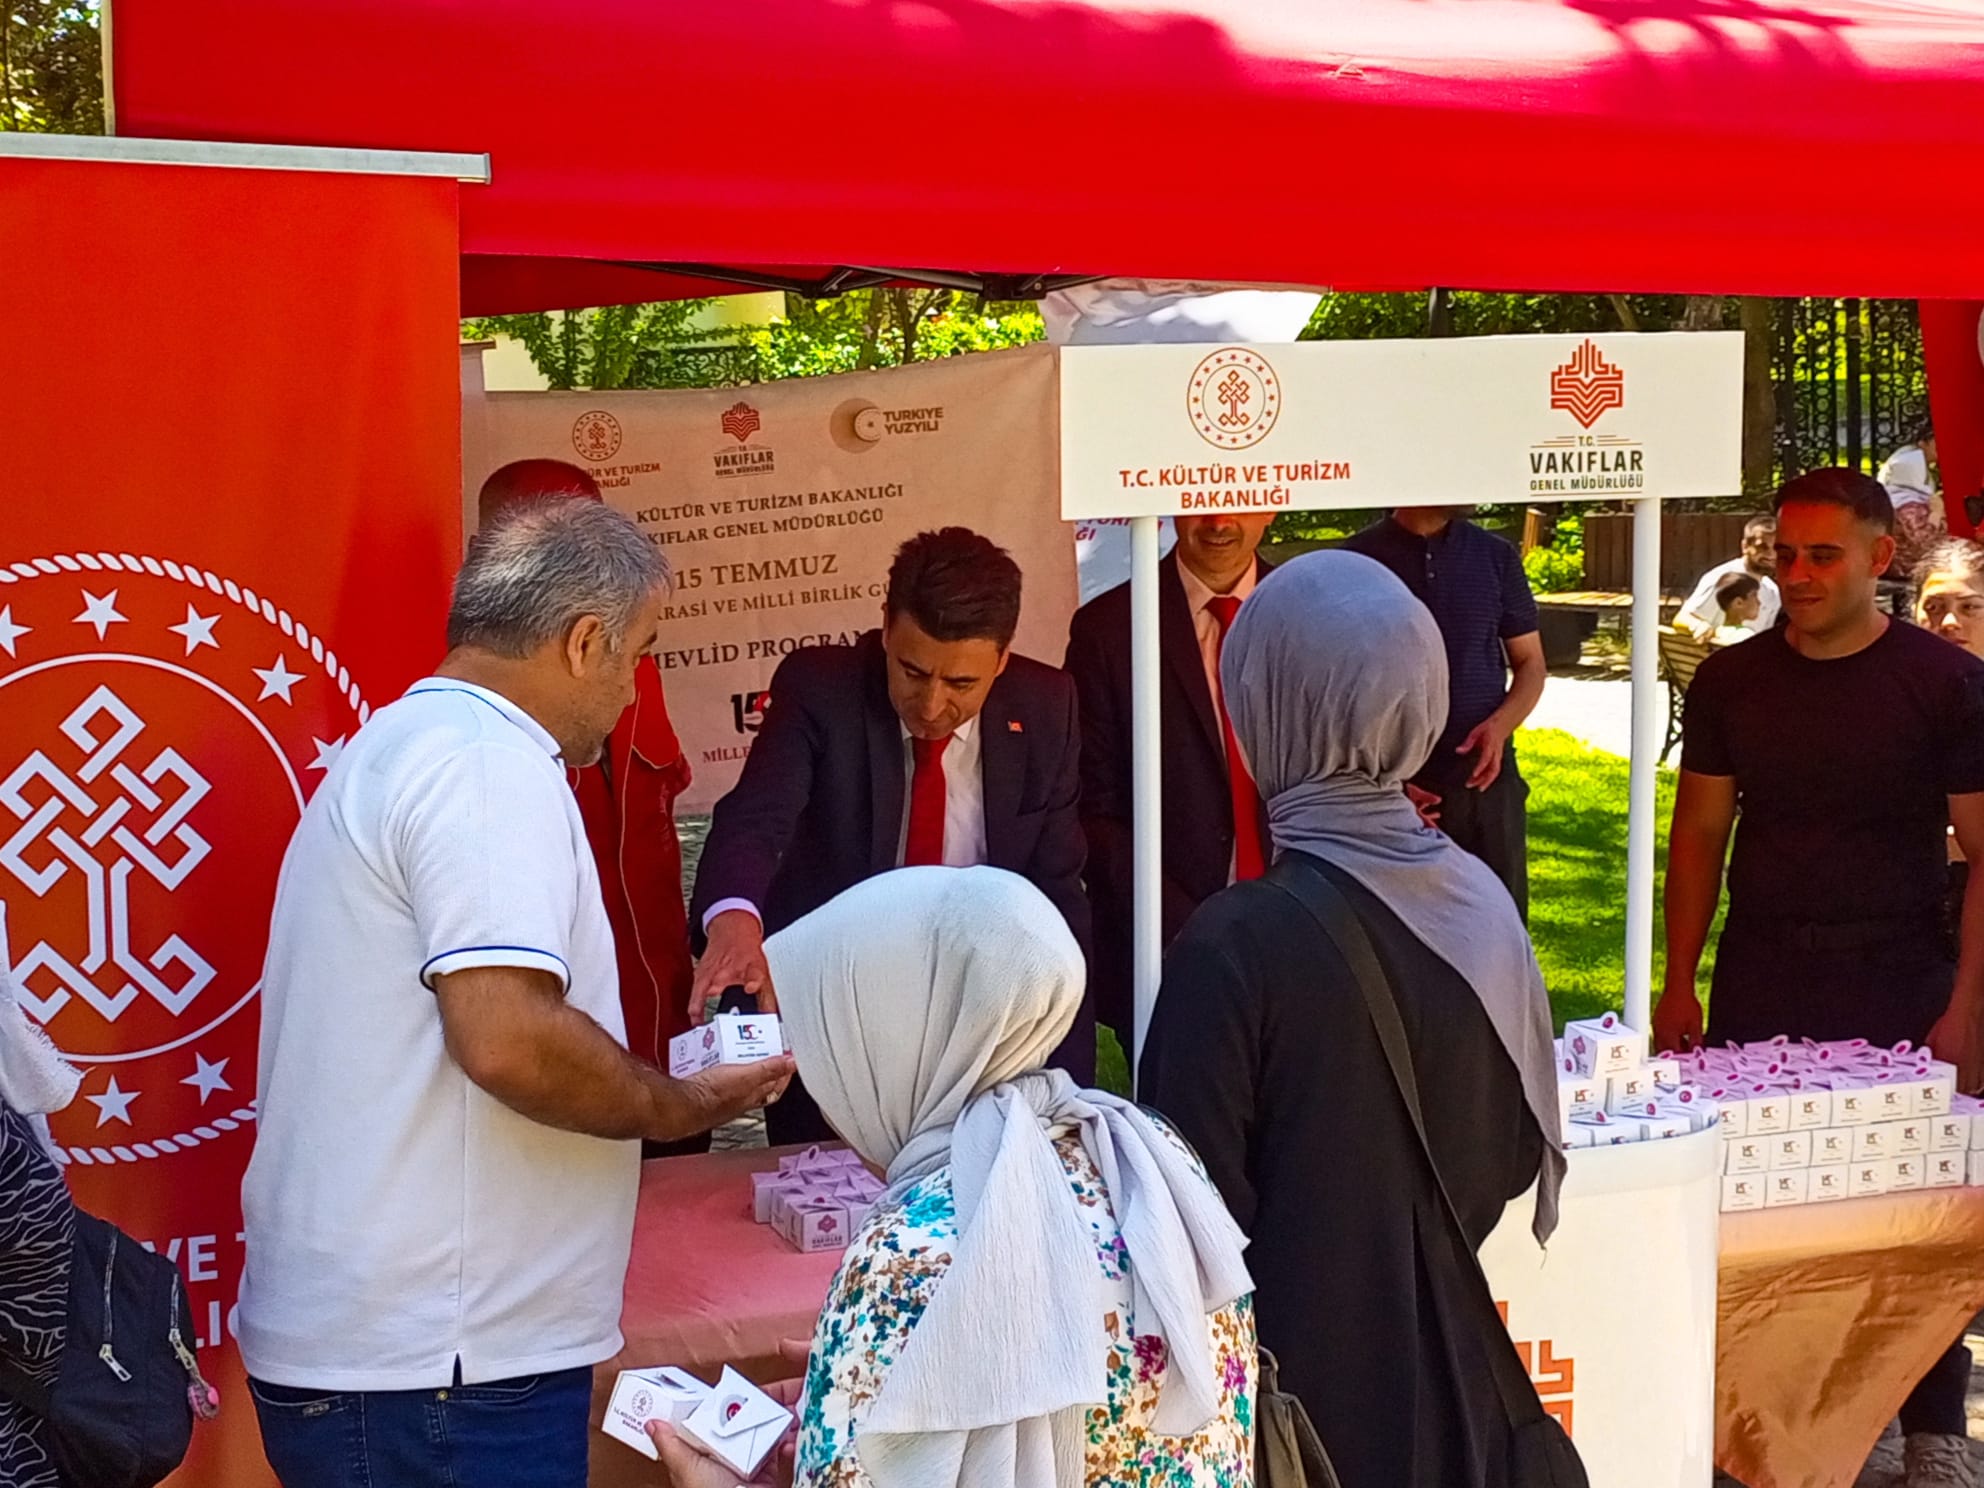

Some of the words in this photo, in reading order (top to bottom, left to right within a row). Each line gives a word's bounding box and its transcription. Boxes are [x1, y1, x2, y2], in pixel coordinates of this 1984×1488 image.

[1578, 436, 1595, 447] T.C.
[604, 466, 618, 477] VE
[620, 463, 660, 475] TURİZM
[714, 451, 774, 467] VAKIFLAR
[1530, 450, 1643, 474] VAKIFLAR
[1119, 470, 1153, 487] T.C.
[1159, 463, 1237, 485] KÜLTÜR
[1242, 466, 1268, 483] VE
[1272, 460, 1351, 481] TURİZM
[1530, 479, 1566, 491] GENEL
[1570, 474, 1644, 490] MÜDÜRLÜĞÜ
[636, 504, 705, 523] KÜLTÜR
[710, 502, 732, 516] VE
[736, 495, 803, 513] TURİZM
[808, 484, 904, 505] BAKANLIĞI
[1181, 485, 1290, 509] BAKANLIĞI
[713, 521, 768, 539] GENEL
[772, 508, 884, 532] MÜDÜRLÜĞÜ
[675, 568, 702, 590] 15
[710, 554, 839, 585] TEMMUZ
[713, 599, 738, 614] VE
[742, 590, 795, 611] MİLLİ
[801, 584, 863, 605] BİRLİK
